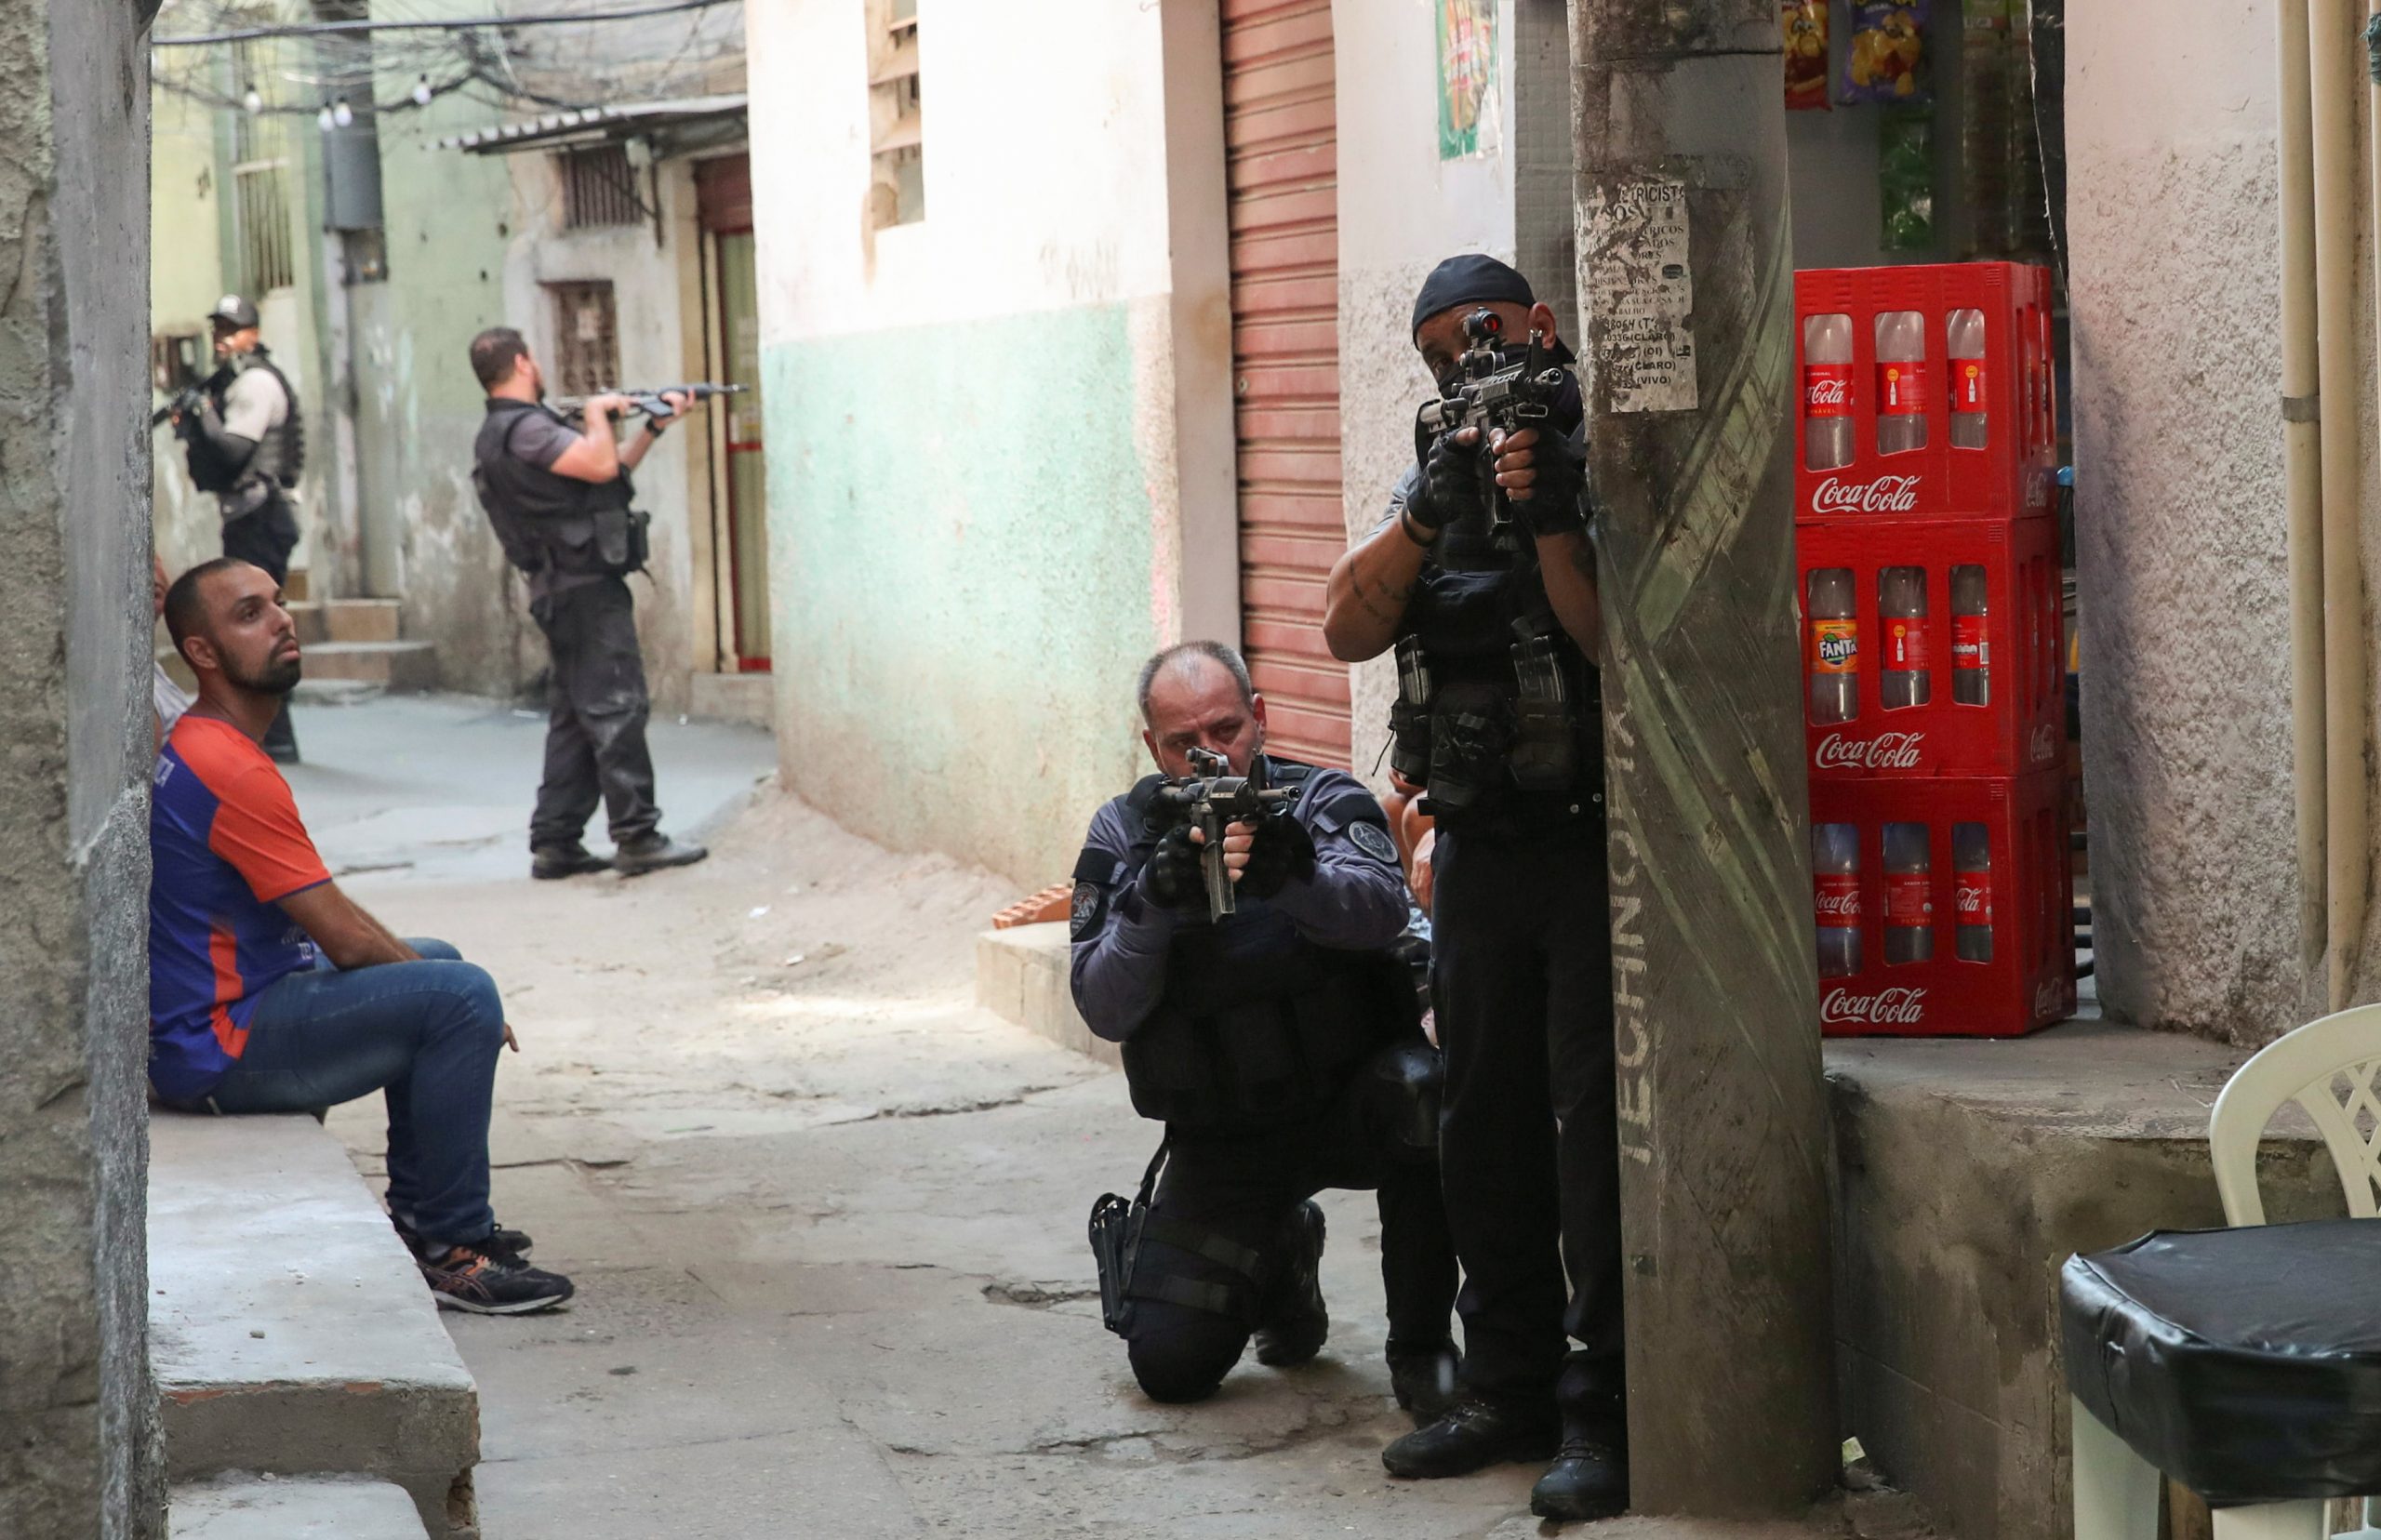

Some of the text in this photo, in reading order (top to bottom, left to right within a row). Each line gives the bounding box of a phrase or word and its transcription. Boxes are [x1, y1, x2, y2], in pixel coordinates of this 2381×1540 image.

[1637, 376, 1671, 385] (VIVO)
[1812, 475, 1922, 513] Coca-Cola
[1818, 637, 1858, 658] FANTA
[1816, 732, 1926, 769] Coca-Cola
[1820, 988, 1928, 1024] Coca-Cola
